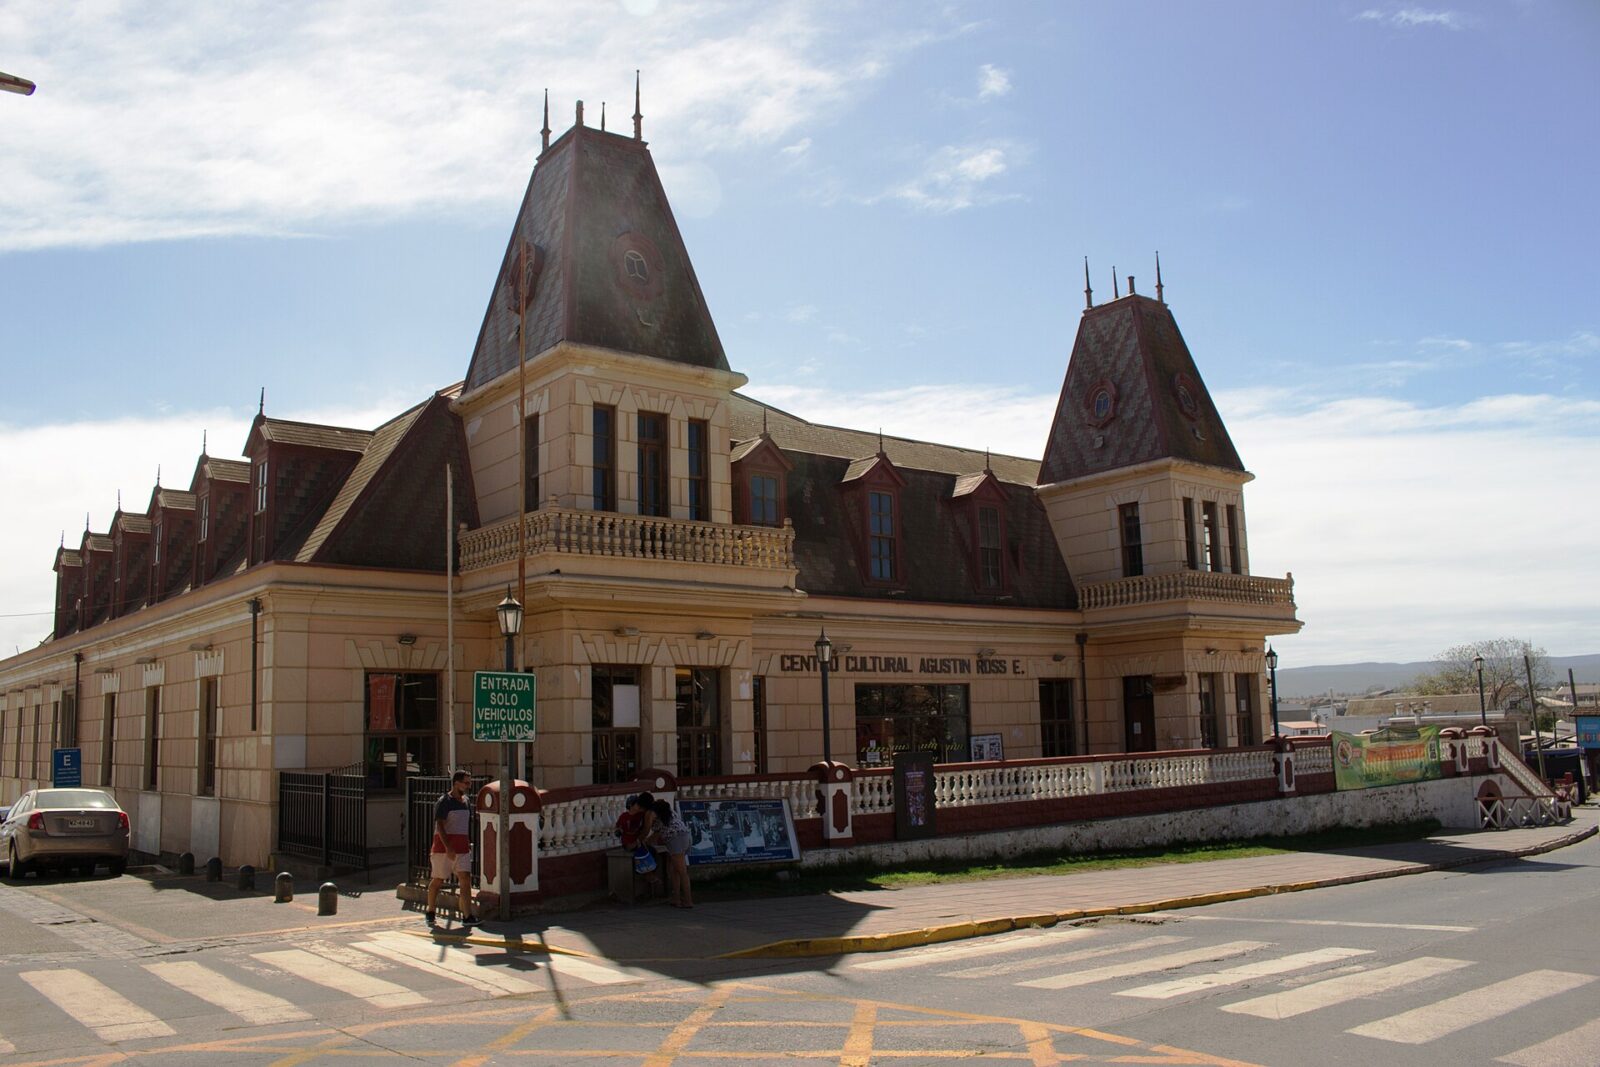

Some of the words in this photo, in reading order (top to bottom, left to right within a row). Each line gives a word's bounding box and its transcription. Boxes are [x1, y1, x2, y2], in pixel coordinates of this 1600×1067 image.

[781, 655, 839, 672] CENTO
[846, 656, 912, 673] CULTURAL
[919, 657, 970, 674] AGUSTIN
[976, 658, 1006, 674] ROSS
[1013, 659, 1025, 675] E.
[481, 677, 530, 691] ENTRADA
[490, 692, 518, 706] SOLO
[477, 707, 533, 721] VEHICULOS
[63, 754, 71, 766] E
